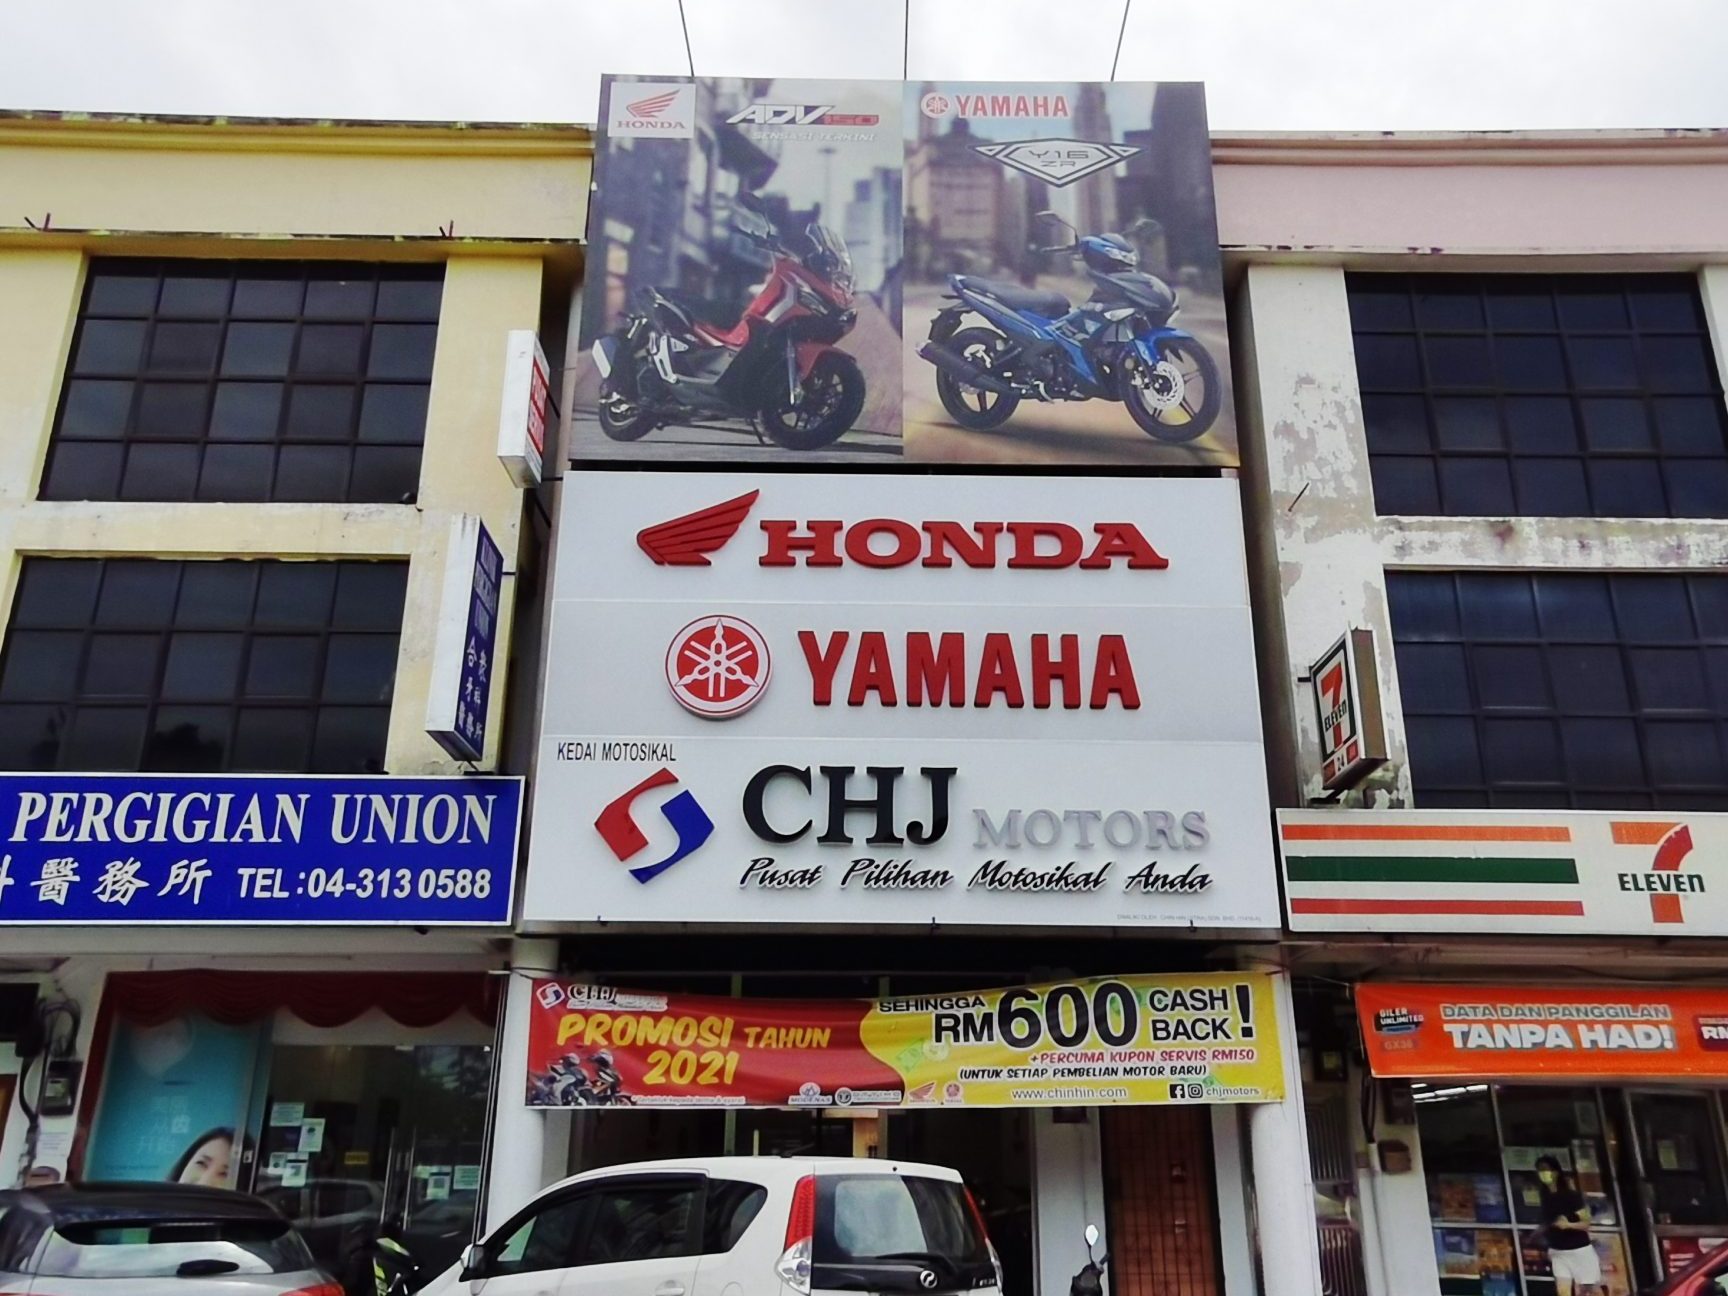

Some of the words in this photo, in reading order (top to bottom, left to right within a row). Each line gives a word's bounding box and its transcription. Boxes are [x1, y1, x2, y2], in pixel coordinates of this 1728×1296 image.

[726, 103, 836, 125] ADV
[956, 95, 1069, 117] YAMAHA
[616, 120, 686, 129] HONDA
[758, 519, 1169, 569] HONDA
[797, 630, 1141, 709] YAMAHA
[557, 742, 597, 761] KEDAI
[601, 742, 677, 762] MOTOSIKAL
[8, 792, 310, 843] PERGIGIAN
[331, 794, 497, 844] UNION
[742, 764, 958, 846] CHJ
[972, 809, 1211, 851] MOTORS
[739, 857, 824, 888] Pusat
[841, 858, 952, 889] Pilihan
[968, 860, 1114, 892] Motosikal
[1124, 861, 1213, 893] Anda
[1609, 821, 1693, 923] 7
[878, 996, 986, 1013] SEHINGGA
[1149, 988, 1229, 1013] CASH
[1441, 1004, 1494, 1019] DATA
[1499, 1005, 1543, 1019] DAN
[1547, 1005, 1670, 1019] PANGGILAN
[556, 1013, 735, 1048] PROMOSI
[745, 1027, 832, 1049] TAHUN
[1442, 1023, 1574, 1049] TANPA
[1577, 1024, 1674, 1050] HAD!
[642, 1050, 741, 1085] 2021
[1110, 1051, 1155, 1063] KUPON
[1160, 1050, 1207, 1062] SERVIS
[1212, 1049, 1255, 1061] RM150
[959, 1068, 1004, 1080] (UNTUK
[1006, 1067, 1049, 1079] SETIAP
[1053, 1067, 1119, 1078] PEMBELIAN
[1123, 1066, 1165, 1077] MOTOR
[1170, 1065, 1207, 1077] BARU)
[1011, 1086, 1128, 1100] www.chinhin.com
[1206, 1086, 1260, 1098] chjmotors
